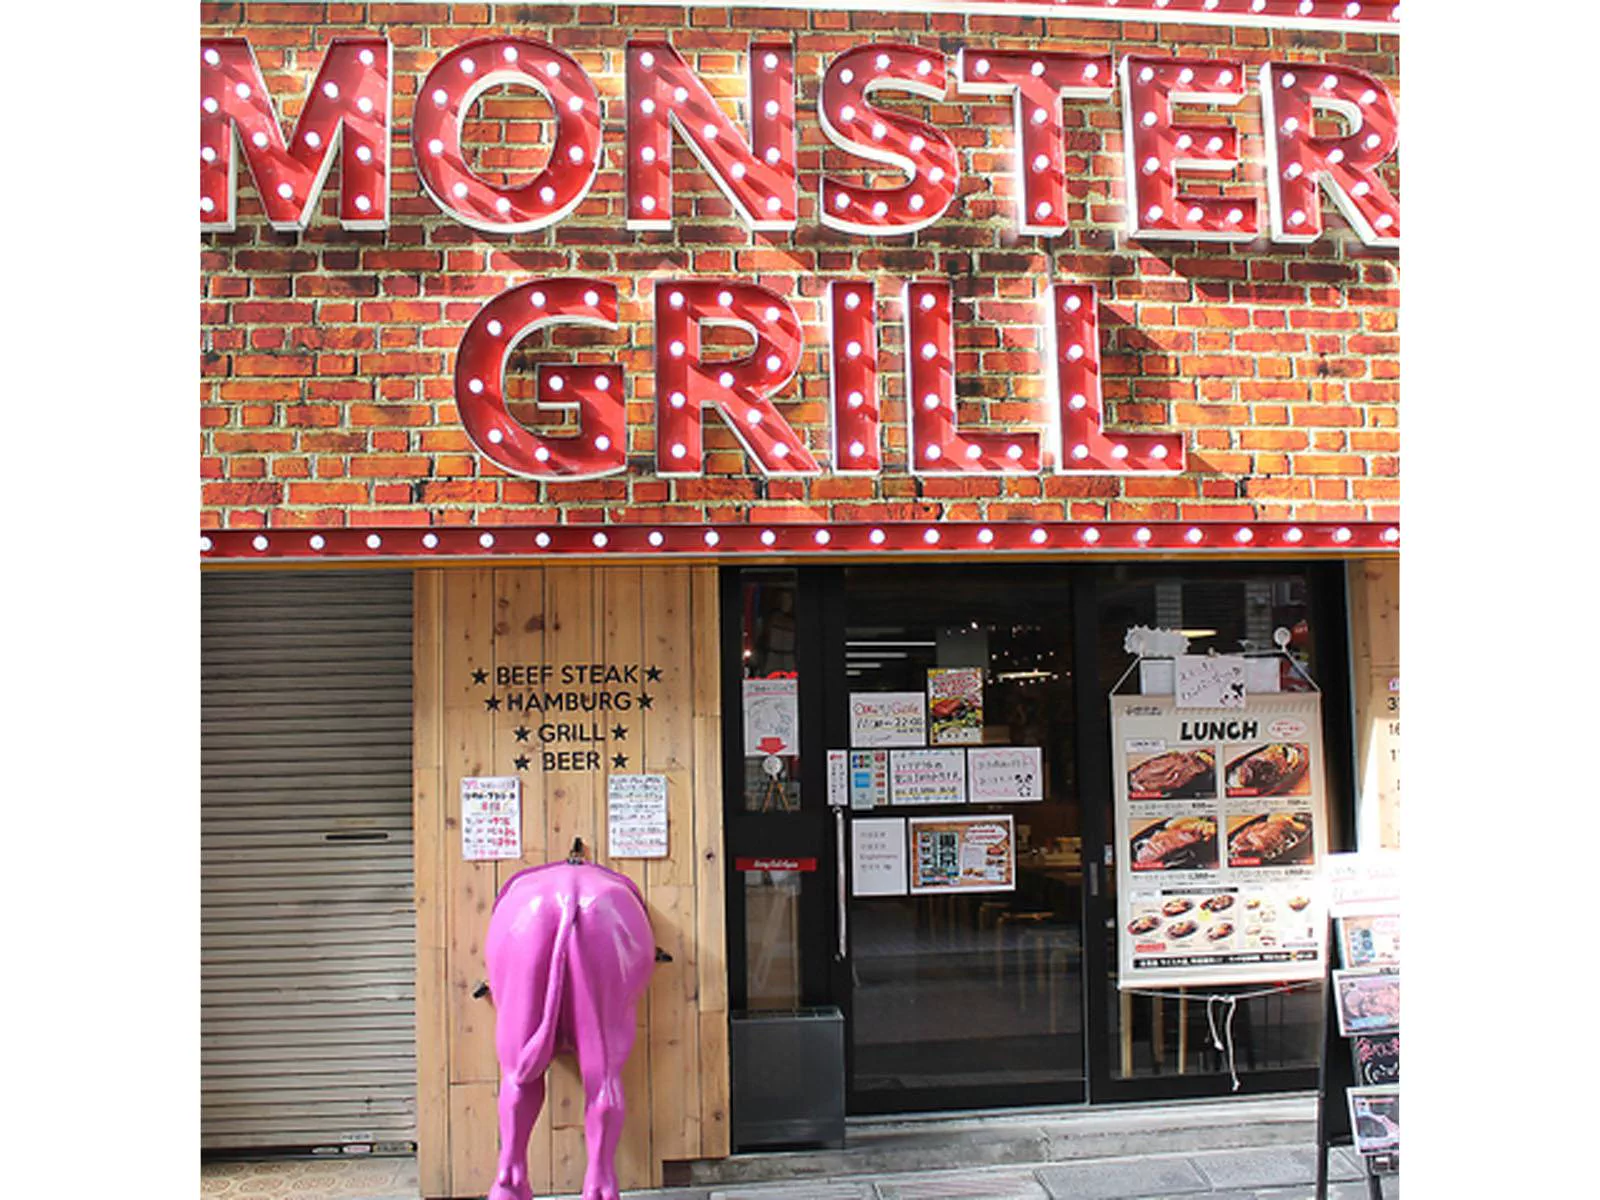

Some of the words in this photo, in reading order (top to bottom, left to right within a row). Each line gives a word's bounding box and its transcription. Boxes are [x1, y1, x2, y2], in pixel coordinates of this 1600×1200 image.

[200, 36, 1400, 248] MONSTER
[453, 275, 1187, 482] GRILL
[495, 665, 553, 686] BEEF
[561, 664, 640, 684] STEAK
[507, 691, 633, 713] HAMBURG
[537, 723, 606, 743] GRILL
[1180, 720, 1259, 741] LUNCH
[542, 751, 602, 771] BEER
